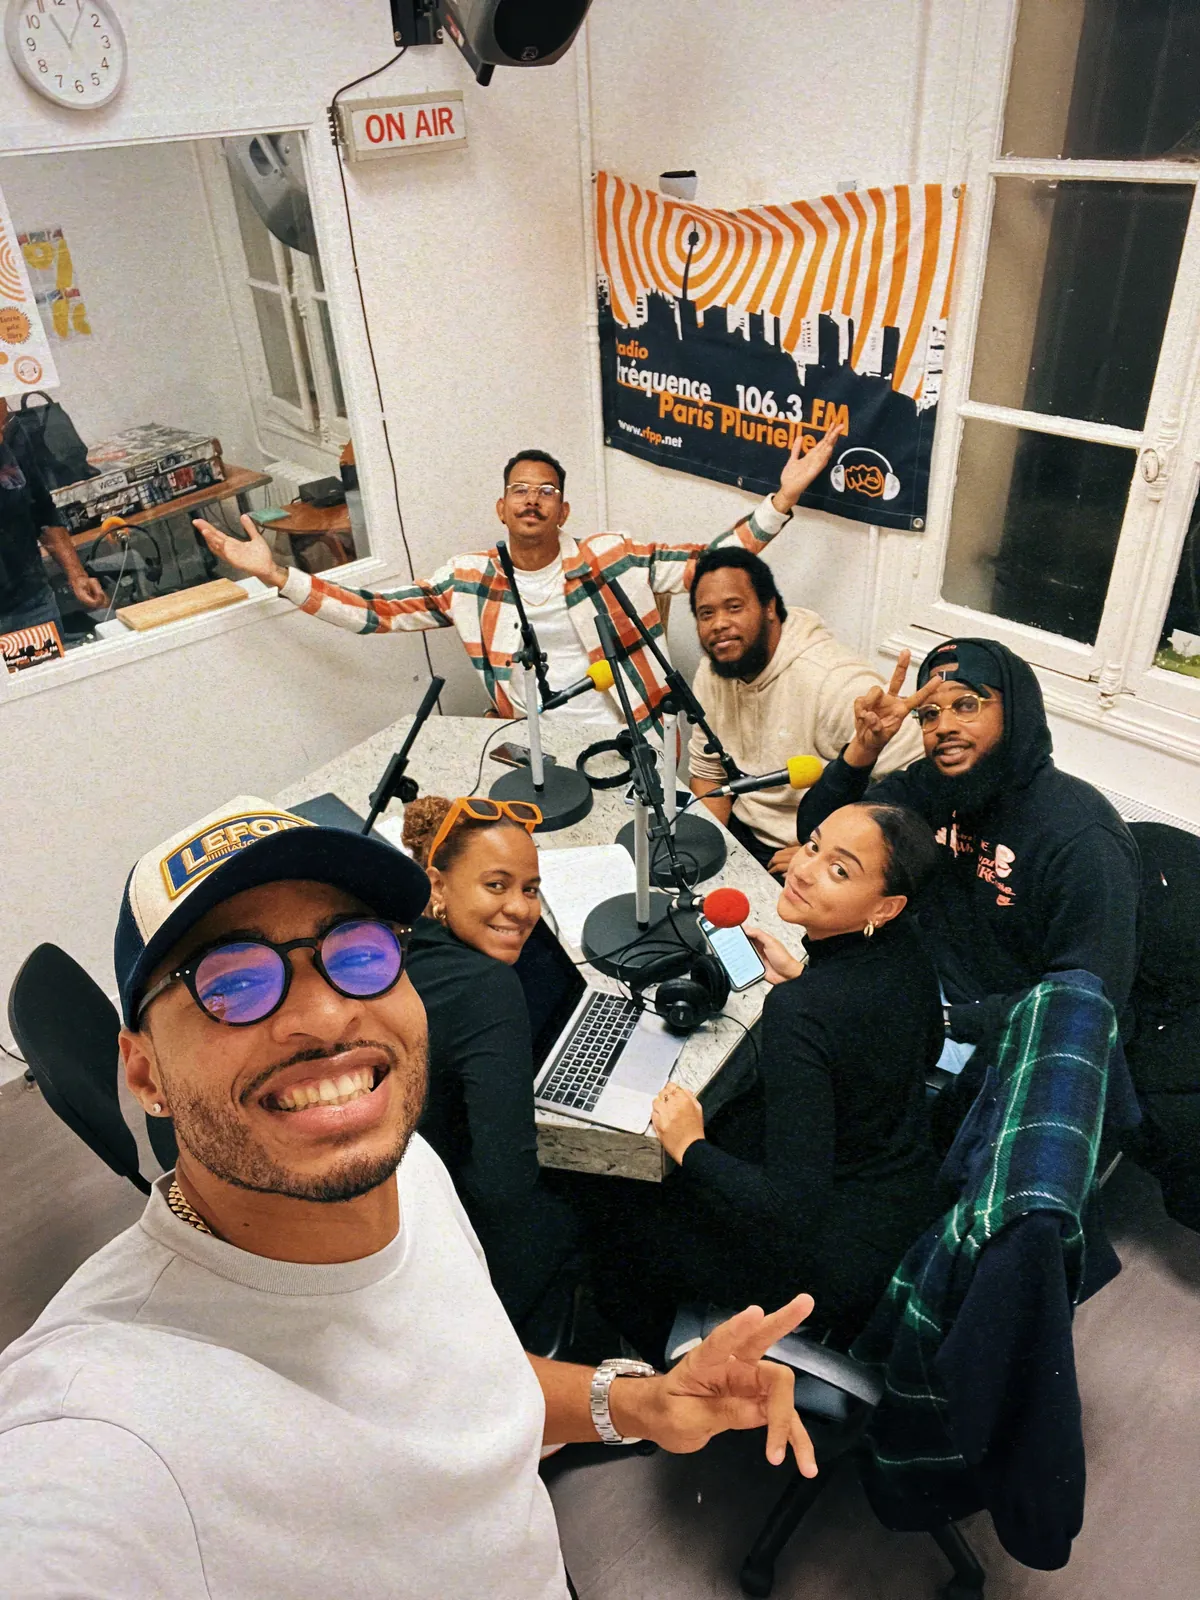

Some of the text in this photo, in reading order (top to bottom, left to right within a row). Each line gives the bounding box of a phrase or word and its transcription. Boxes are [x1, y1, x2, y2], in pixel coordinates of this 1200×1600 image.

[26, 14, 40, 29] 10
[91, 13, 101, 28] 2
[26, 37, 36, 51] 9
[100, 35, 111, 49] 3
[37, 59, 48, 73] 8
[101, 57, 110, 70] 4
[54, 74, 63, 88] 7
[91, 72, 100, 86] 5
[74, 80, 84, 93] 6
[365, 107, 455, 144] ON AIR
[616, 337, 649, 359] adio
[658, 391, 714, 430] Paris
[736, 384, 803, 423] 106.3
[811, 398, 849, 437] FM
[618, 419, 683, 448] www.rfpp.net
